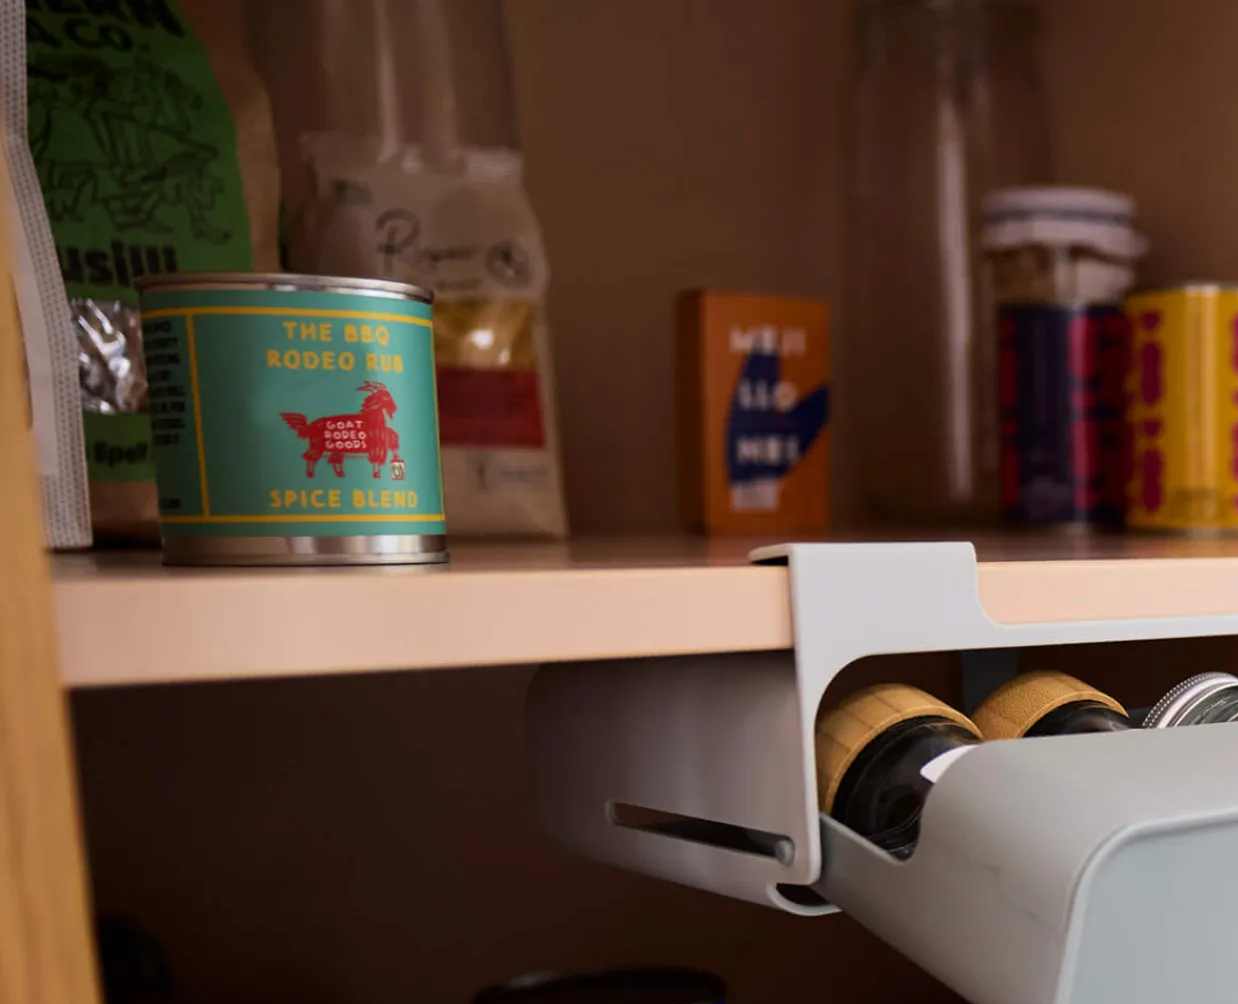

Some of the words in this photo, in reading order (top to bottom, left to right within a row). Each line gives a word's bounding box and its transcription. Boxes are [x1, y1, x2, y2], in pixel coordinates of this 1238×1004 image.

[282, 321, 333, 342] THE
[343, 324, 390, 347] BBQ
[267, 349, 355, 371] RODEO
[365, 352, 404, 373] RUB
[326, 420, 364, 430] GOAT
[324, 430, 366, 440] RODEO
[325, 440, 367, 449] GOODS
[269, 489, 342, 508] SPICE
[353, 490, 418, 508] BLEND
